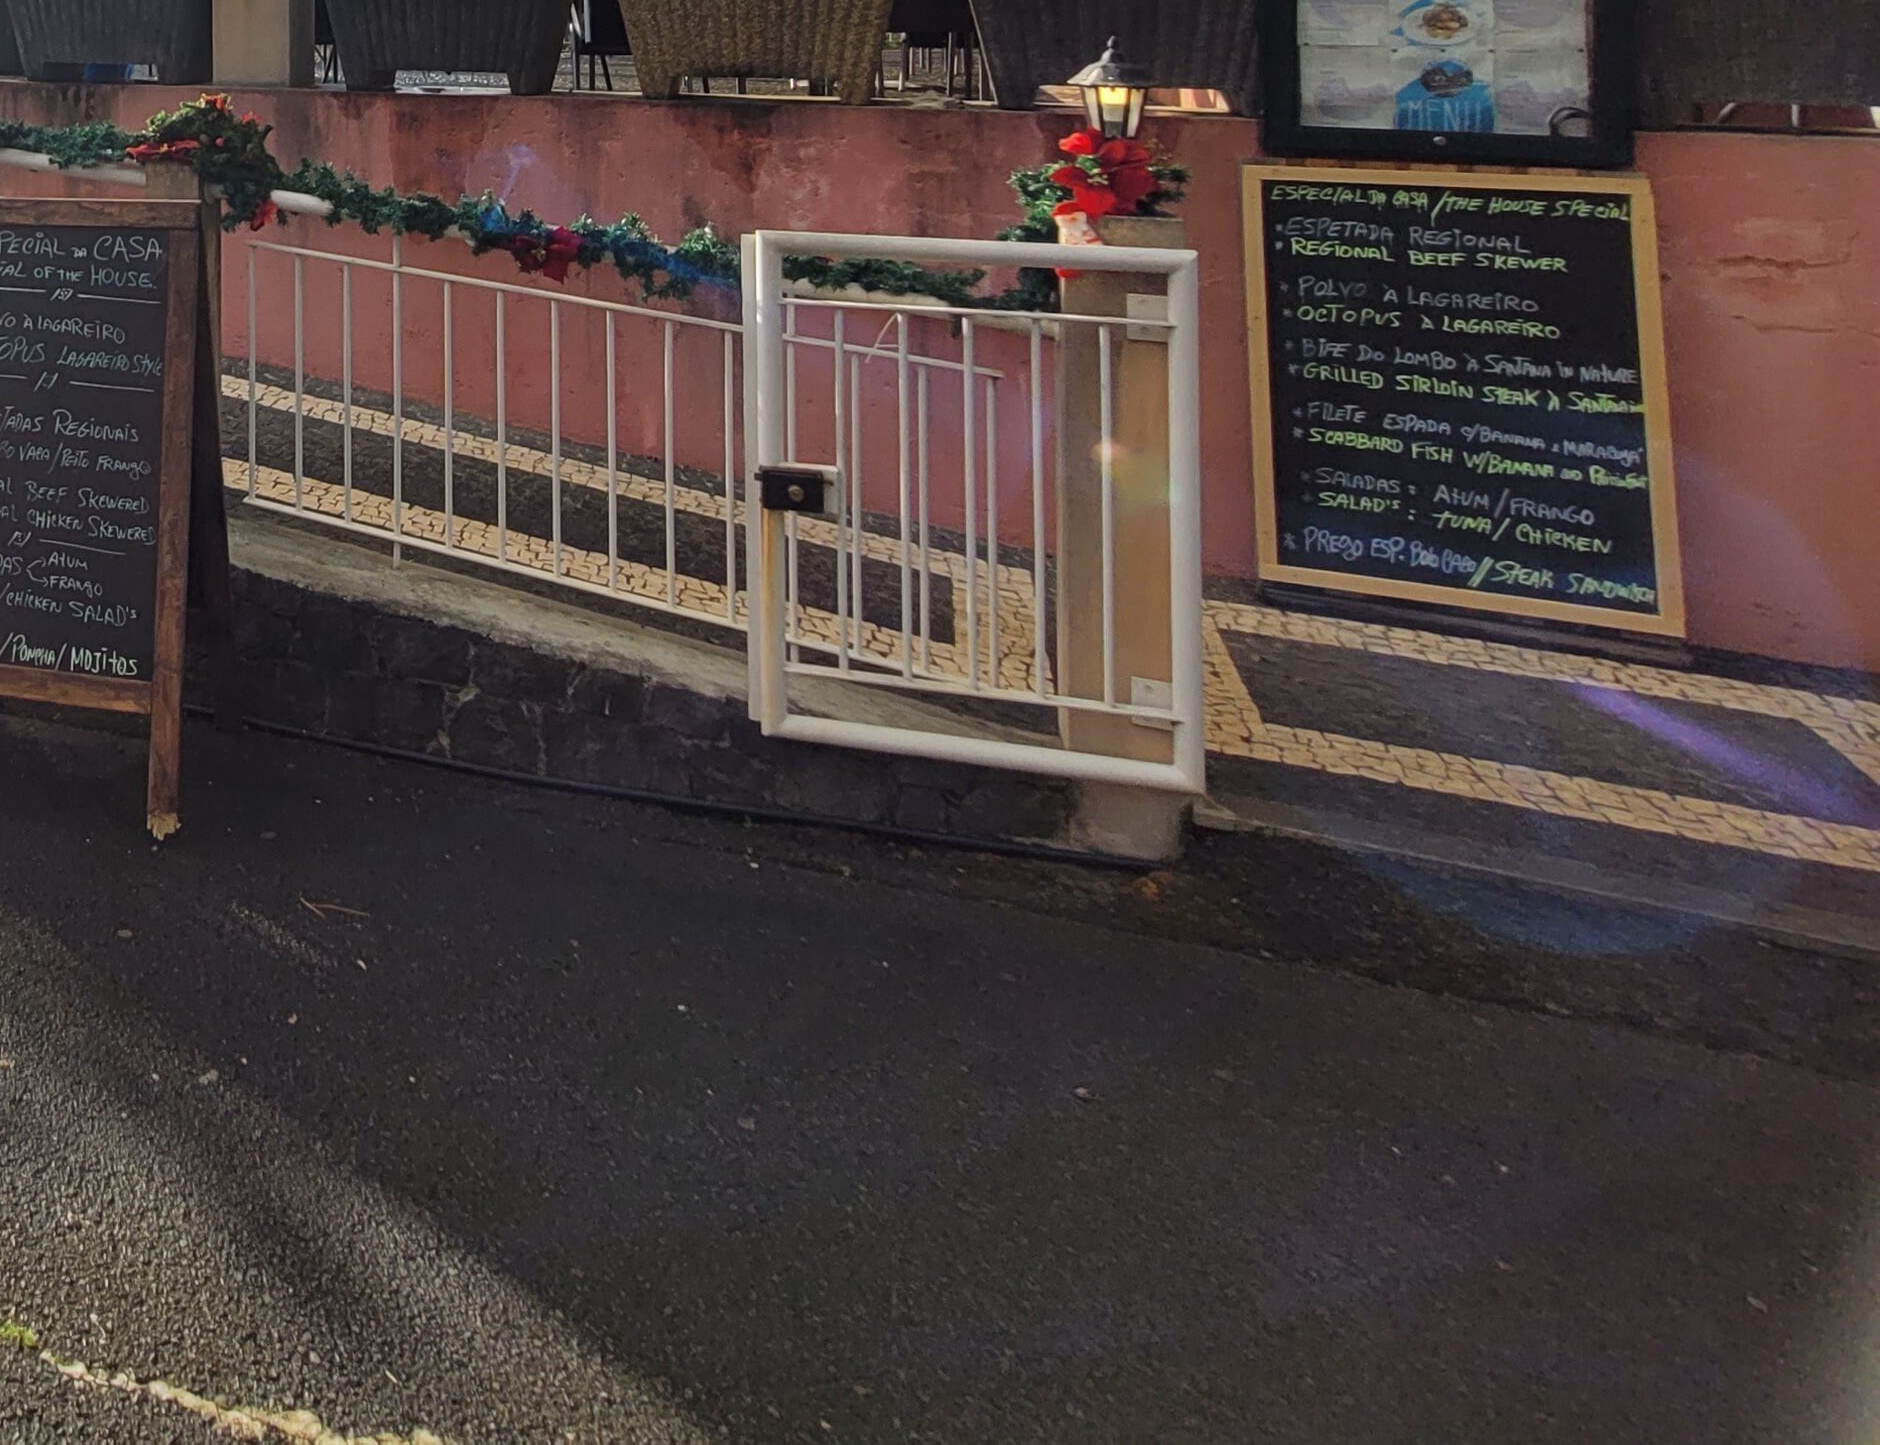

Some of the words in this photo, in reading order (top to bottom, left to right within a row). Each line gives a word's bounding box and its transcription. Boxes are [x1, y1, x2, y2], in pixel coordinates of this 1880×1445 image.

[1487, 197, 1548, 215] HOUSE
[93, 236, 162, 262] CASA
[1285, 217, 1394, 244] ESPETADA
[1409, 226, 1531, 254] REGIONAL
[1290, 237, 1395, 262] REGIONAL
[1408, 250, 1467, 267] BEEF
[1474, 252, 1568, 273] SKEWER
[34, 266, 55, 278] OF
[58, 269, 85, 282] THE
[1298, 275, 1367, 301] POLVO
[1407, 285, 1539, 312] LAGAREIRO
[1297, 304, 1402, 327] OCTOPUS
[1442, 315, 1560, 339] LAGAREIRO
[1303, 362, 1384, 389] GRILLED
[1481, 385, 1541, 407] STEAK
[53, 409, 139, 442] REGIONAIS
[1307, 402, 1367, 424] FILETE
[1382, 413, 1452, 435] ESPADA
[1307, 427, 1404, 453] SCABBARD
[1411, 442, 1454, 464] FISH
[25, 480, 69, 503] BEEF
